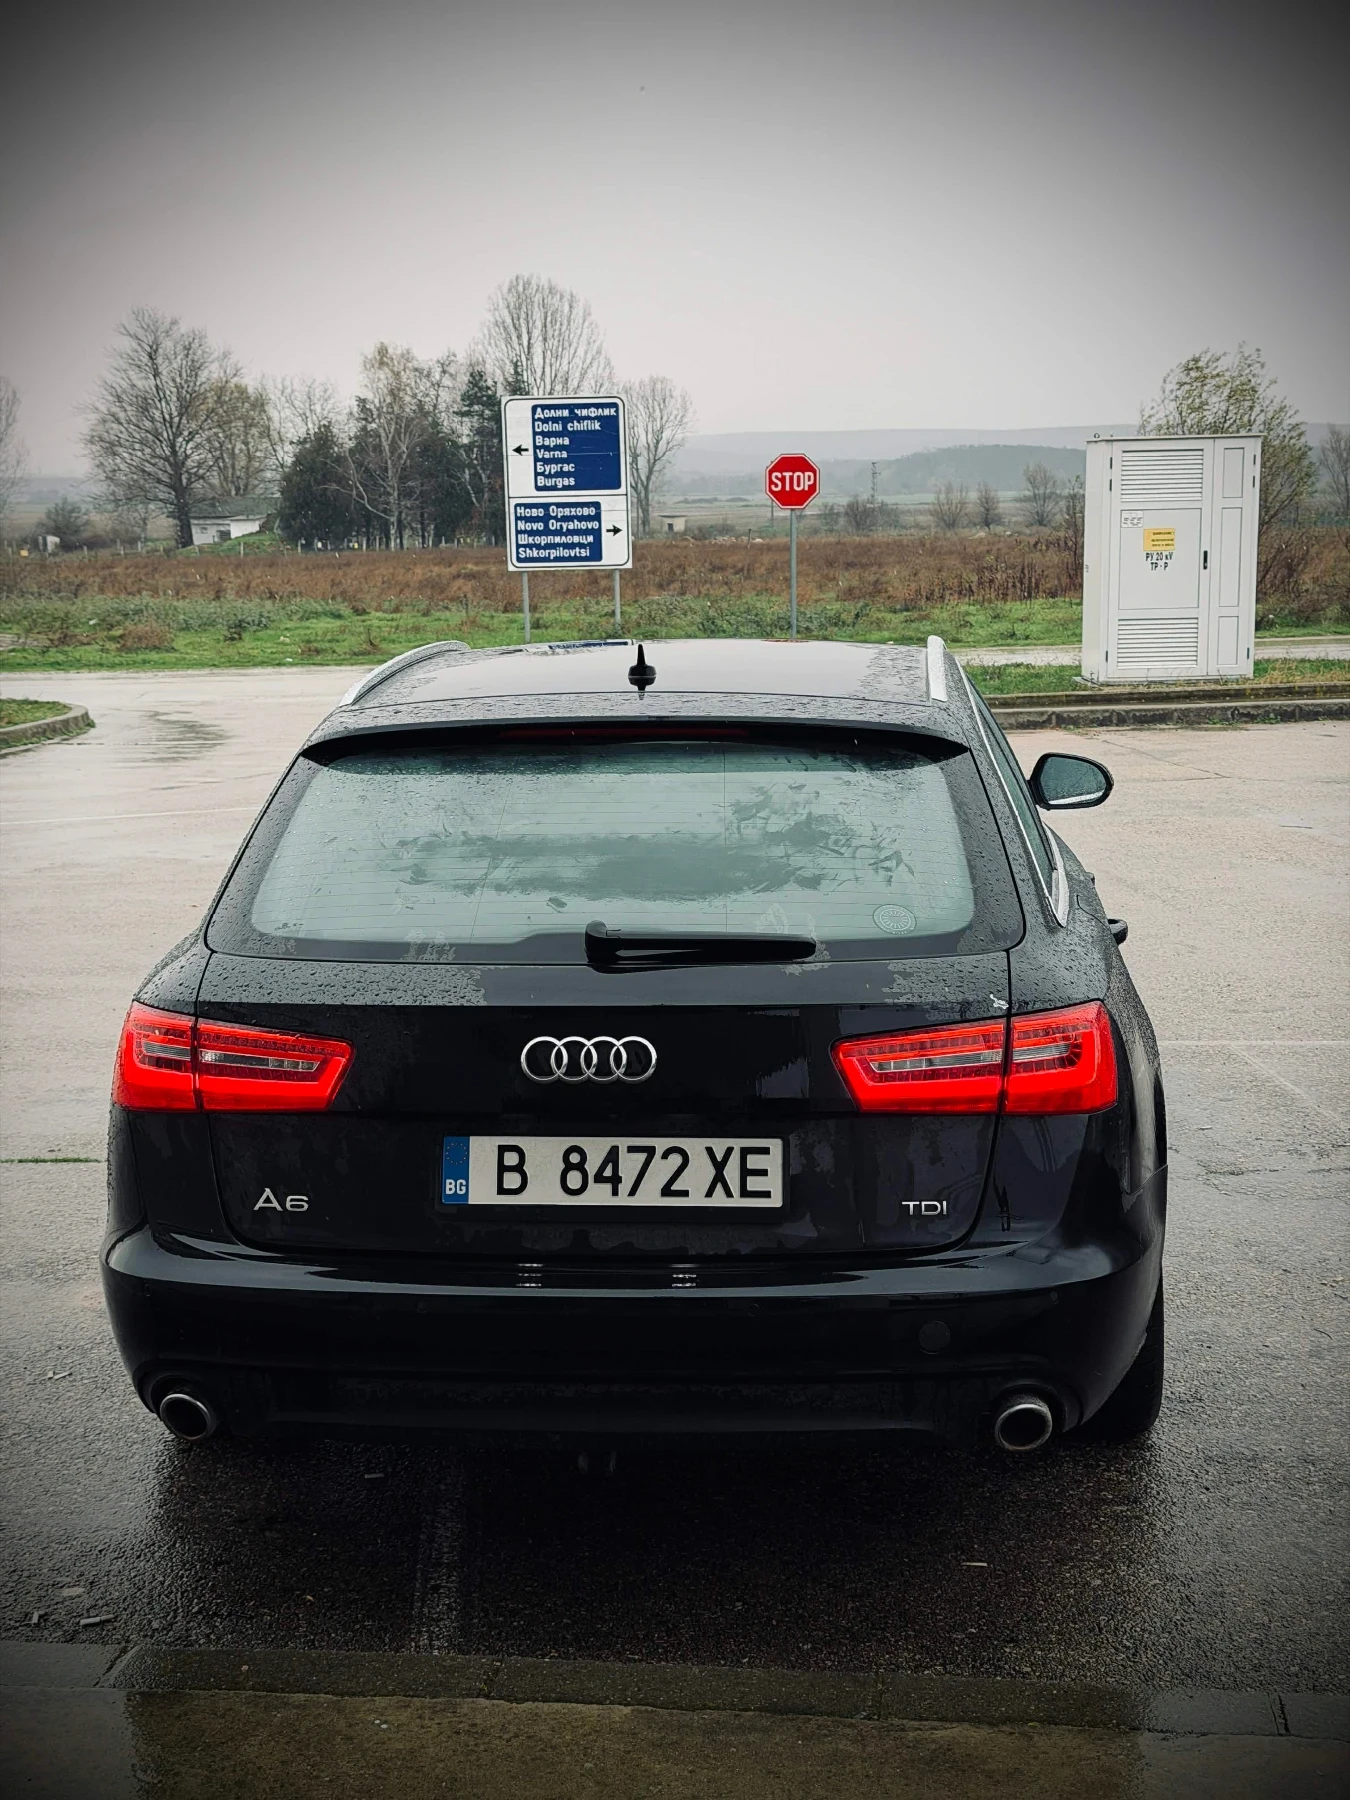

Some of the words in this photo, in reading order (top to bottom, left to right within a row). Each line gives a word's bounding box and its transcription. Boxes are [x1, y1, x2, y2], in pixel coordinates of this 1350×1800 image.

[535, 407, 569, 419] Долни
[575, 407, 617, 418] чифлик
[535, 421, 562, 431] Dolni
[567, 420, 601, 431] chiflik
[536, 436, 570, 447] Варна
[536, 449, 568, 458] Varna
[536, 462, 575, 474] Бургас
[537, 477, 575, 488] Burgas
[771, 472, 815, 491] STOP
[516, 506, 544, 517] Ново
[549, 505, 596, 518] Оряхово
[517, 520, 544, 531] Novo
[549, 519, 599, 532] Oryahovo
[517, 534, 594, 546] Шкорпиловци
[518, 547, 590, 559] Shkorpilovtsi
[1156, 552, 1163, 561] 20
[445, 1179, 466, 1195] BG
[496, 1144, 529, 1196] B
[559, 1144, 690, 1198] 8472
[704, 1146, 772, 1199] XE
[253, 1187, 309, 1212] A6
[901, 1200, 947, 1215] TDI
